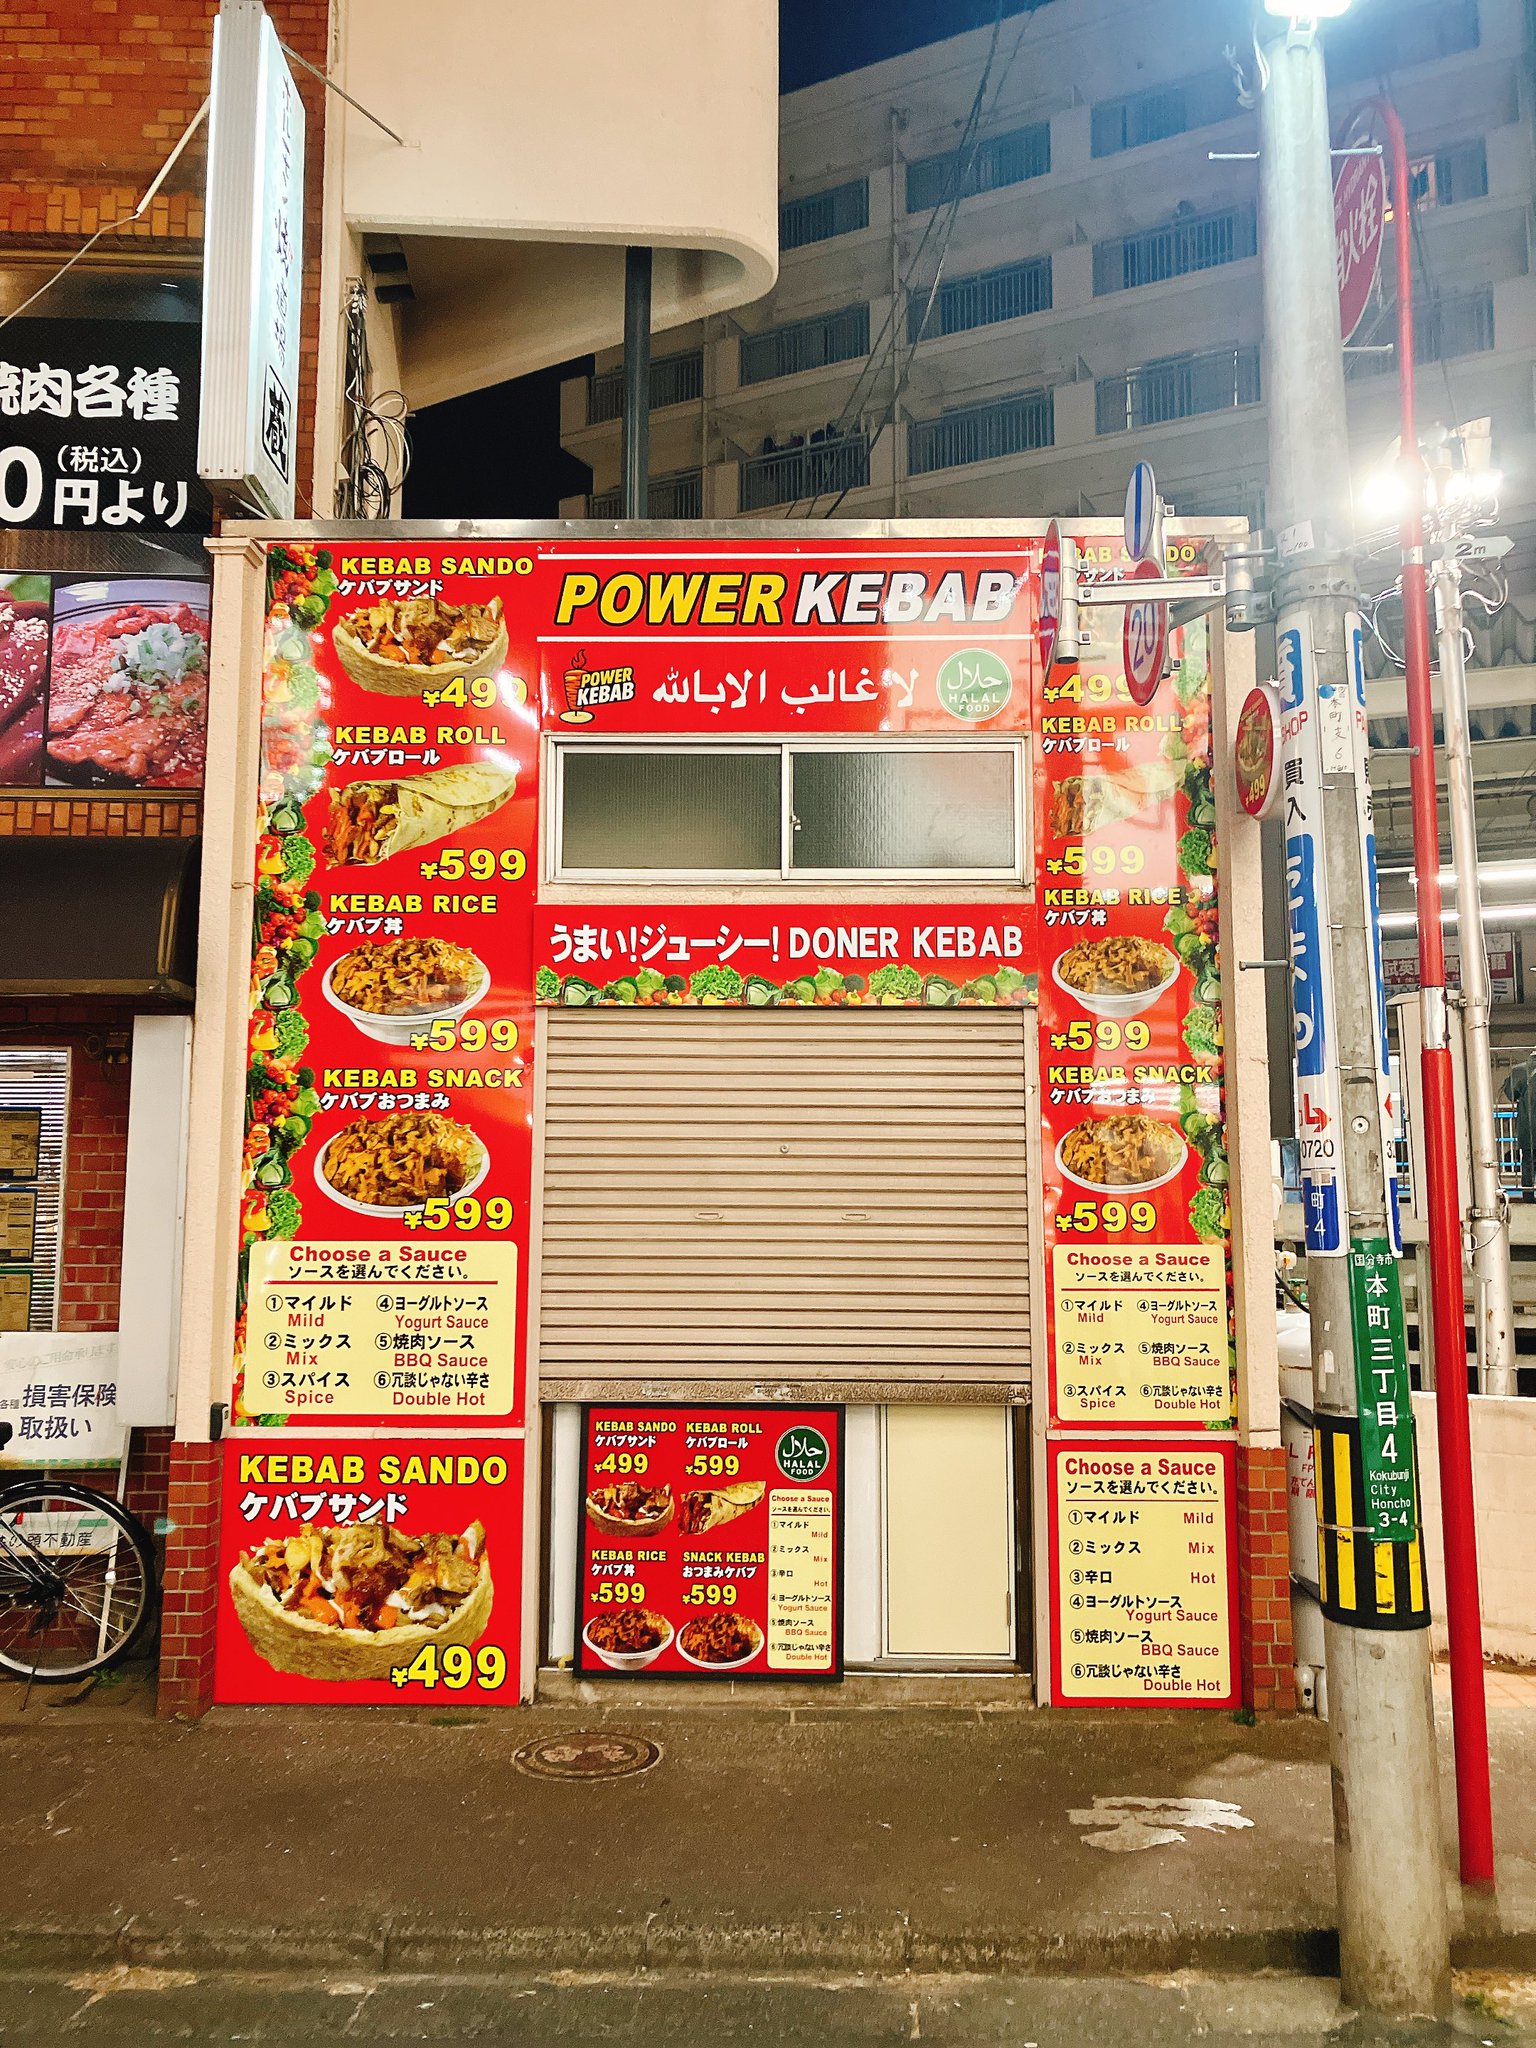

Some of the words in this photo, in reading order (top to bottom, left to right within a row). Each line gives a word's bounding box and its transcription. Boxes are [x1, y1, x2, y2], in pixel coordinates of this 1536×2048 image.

[341, 558, 432, 575] KEBAB
[441, 557, 534, 575] SANDO
[338, 579, 444, 596] ケバブサンド
[554, 572, 788, 624] POWER
[792, 571, 1017, 624] KEBAB
[580, 667, 632, 688] POWER
[577, 682, 635, 706] KEBAB
[948, 694, 1000, 704] HALAL
[959, 704, 990, 712] FOOD
[1041, 716, 1116, 733] KEBAB
[1125, 716, 1182, 732] ROLL
[335, 726, 427, 744] KEBAB
[437, 726, 506, 744] ROLL
[1041, 737, 1131, 753] ケバブロール
[332, 749, 441, 766] ケバブロール
[1284, 757, 1306, 826] 買入
[420, 848, 528, 881] ¥599
[1046, 845, 1145, 875] ¥599
[330, 894, 423, 913] KEBAB
[432, 894, 498, 913] RICE
[1044, 889, 1120, 906] KEBAB
[1129, 888, 1181, 905] RICE
[1044, 910, 1107, 926] ケバブ丼
[326, 918, 403, 935] ケバブ丼
[789, 927, 900, 958] DONER
[913, 926, 1024, 958] KEBAB
[410, 1019, 519, 1052] ¥599
[1050, 1021, 1150, 1051] ¥599
[323, 1069, 417, 1088] KEBAB
[428, 1069, 523, 1088] SNACK
[1048, 1066, 1126, 1084] KEBAB
[1134, 1066, 1212, 1084] SNACK
[320, 1092, 450, 1110] ケバブおつまみ
[1302, 1139, 1334, 1158] 0720
[404, 1196, 514, 1231] ¥599
[1056, 1201, 1157, 1232] ¥599
[290, 1246, 372, 1262] Choose
[378, 1250, 391, 1262] a
[399, 1246, 468, 1262] Sauce
[1067, 1253, 1133, 1266] Choose
[1138, 1255, 1149, 1265] a
[1155, 1253, 1210, 1266] Sauce
[1354, 1253, 1393, 1267] 国分寺市
[288, 1264, 470, 1280] ソースを選んでください。
[1075, 1271, 1204, 1283] ソースを選んでください。
[288, 1314, 324, 1327] Mild
[395, 1315, 442, 1331] Yogurt
[446, 1316, 488, 1328] Sauce
[1078, 1313, 1104, 1323] Mild
[1151, 1314, 1185, 1326] Yogurt
[1188, 1314, 1218, 1324] Sauce
[286, 1352, 318, 1365] Mix
[394, 1354, 432, 1368] BBQ
[438, 1354, 488, 1367] Sauce
[1079, 1356, 1102, 1365] Mix
[1153, 1357, 1180, 1367] BBQ
[1184, 1357, 1220, 1366] Sauce
[23, 1383, 116, 1407] 損害保険
[284, 1390, 334, 1407] Spice
[393, 1392, 450, 1406] Double
[456, 1392, 485, 1406] Hot
[1080, 1399, 1116, 1410] Spice
[1155, 1400, 1196, 1409] Double
[1200, 1400, 1220, 1409] Hot
[18, 1416, 92, 1439] 取扱い
[595, 1422, 633, 1432] KEBAB
[638, 1422, 676, 1432] SANDO
[686, 1423, 727, 1433] KEBAB
[731, 1423, 763, 1434] ROLL
[594, 1435, 657, 1448] ケバブサンド
[686, 1436, 749, 1449] ケバブロール
[239, 1455, 366, 1483] KEBAB
[379, 1456, 508, 1484] SANDO
[594, 1453, 649, 1474] ¥499
[685, 1455, 740, 1476] ¥599
[783, 1460, 821, 1468] HALAL
[1065, 1458, 1135, 1476] Choose
[1141, 1462, 1152, 1476] a
[1158, 1458, 1216, 1476] Sauce
[791, 1468, 814, 1476] FOOD
[1369, 1469, 1410, 1482] Kokubunji
[1067, 1480, 1218, 1495] ソースを選んでください。
[1371, 1484, 1397, 1496] City
[239, 1491, 408, 1523] ケバブサンド
[771, 1495, 798, 1503] Choose
[807, 1495, 830, 1503] Sauce
[1372, 1497, 1411, 1509] Honcho
[1184, 1513, 1214, 1524] Mild
[1379, 1511, 1408, 1527] 3-4
[592, 1550, 633, 1561] KEBAB
[638, 1550, 667, 1561] RICE
[1188, 1542, 1215, 1553] Mix
[683, 1551, 722, 1562] SNACK
[726, 1552, 765, 1563] KEBAB
[591, 1564, 635, 1577] ケバブ丼
[682, 1565, 757, 1579] おつまみケバブ
[1191, 1572, 1216, 1584] Hot
[591, 1583, 645, 1603] ¥599
[682, 1584, 737, 1605] ¥599
[778, 1604, 803, 1612] Yogurt
[1126, 1609, 1172, 1624] Yogurt
[1176, 1610, 1218, 1621] Sauce
[786, 1653, 813, 1661] Double
[1142, 1644, 1173, 1657] BBQ
[1177, 1645, 1219, 1656] Sauce
[391, 1644, 507, 1689] ¥499
[1143, 1679, 1192, 1691] Double
[1197, 1680, 1221, 1691] Hot
